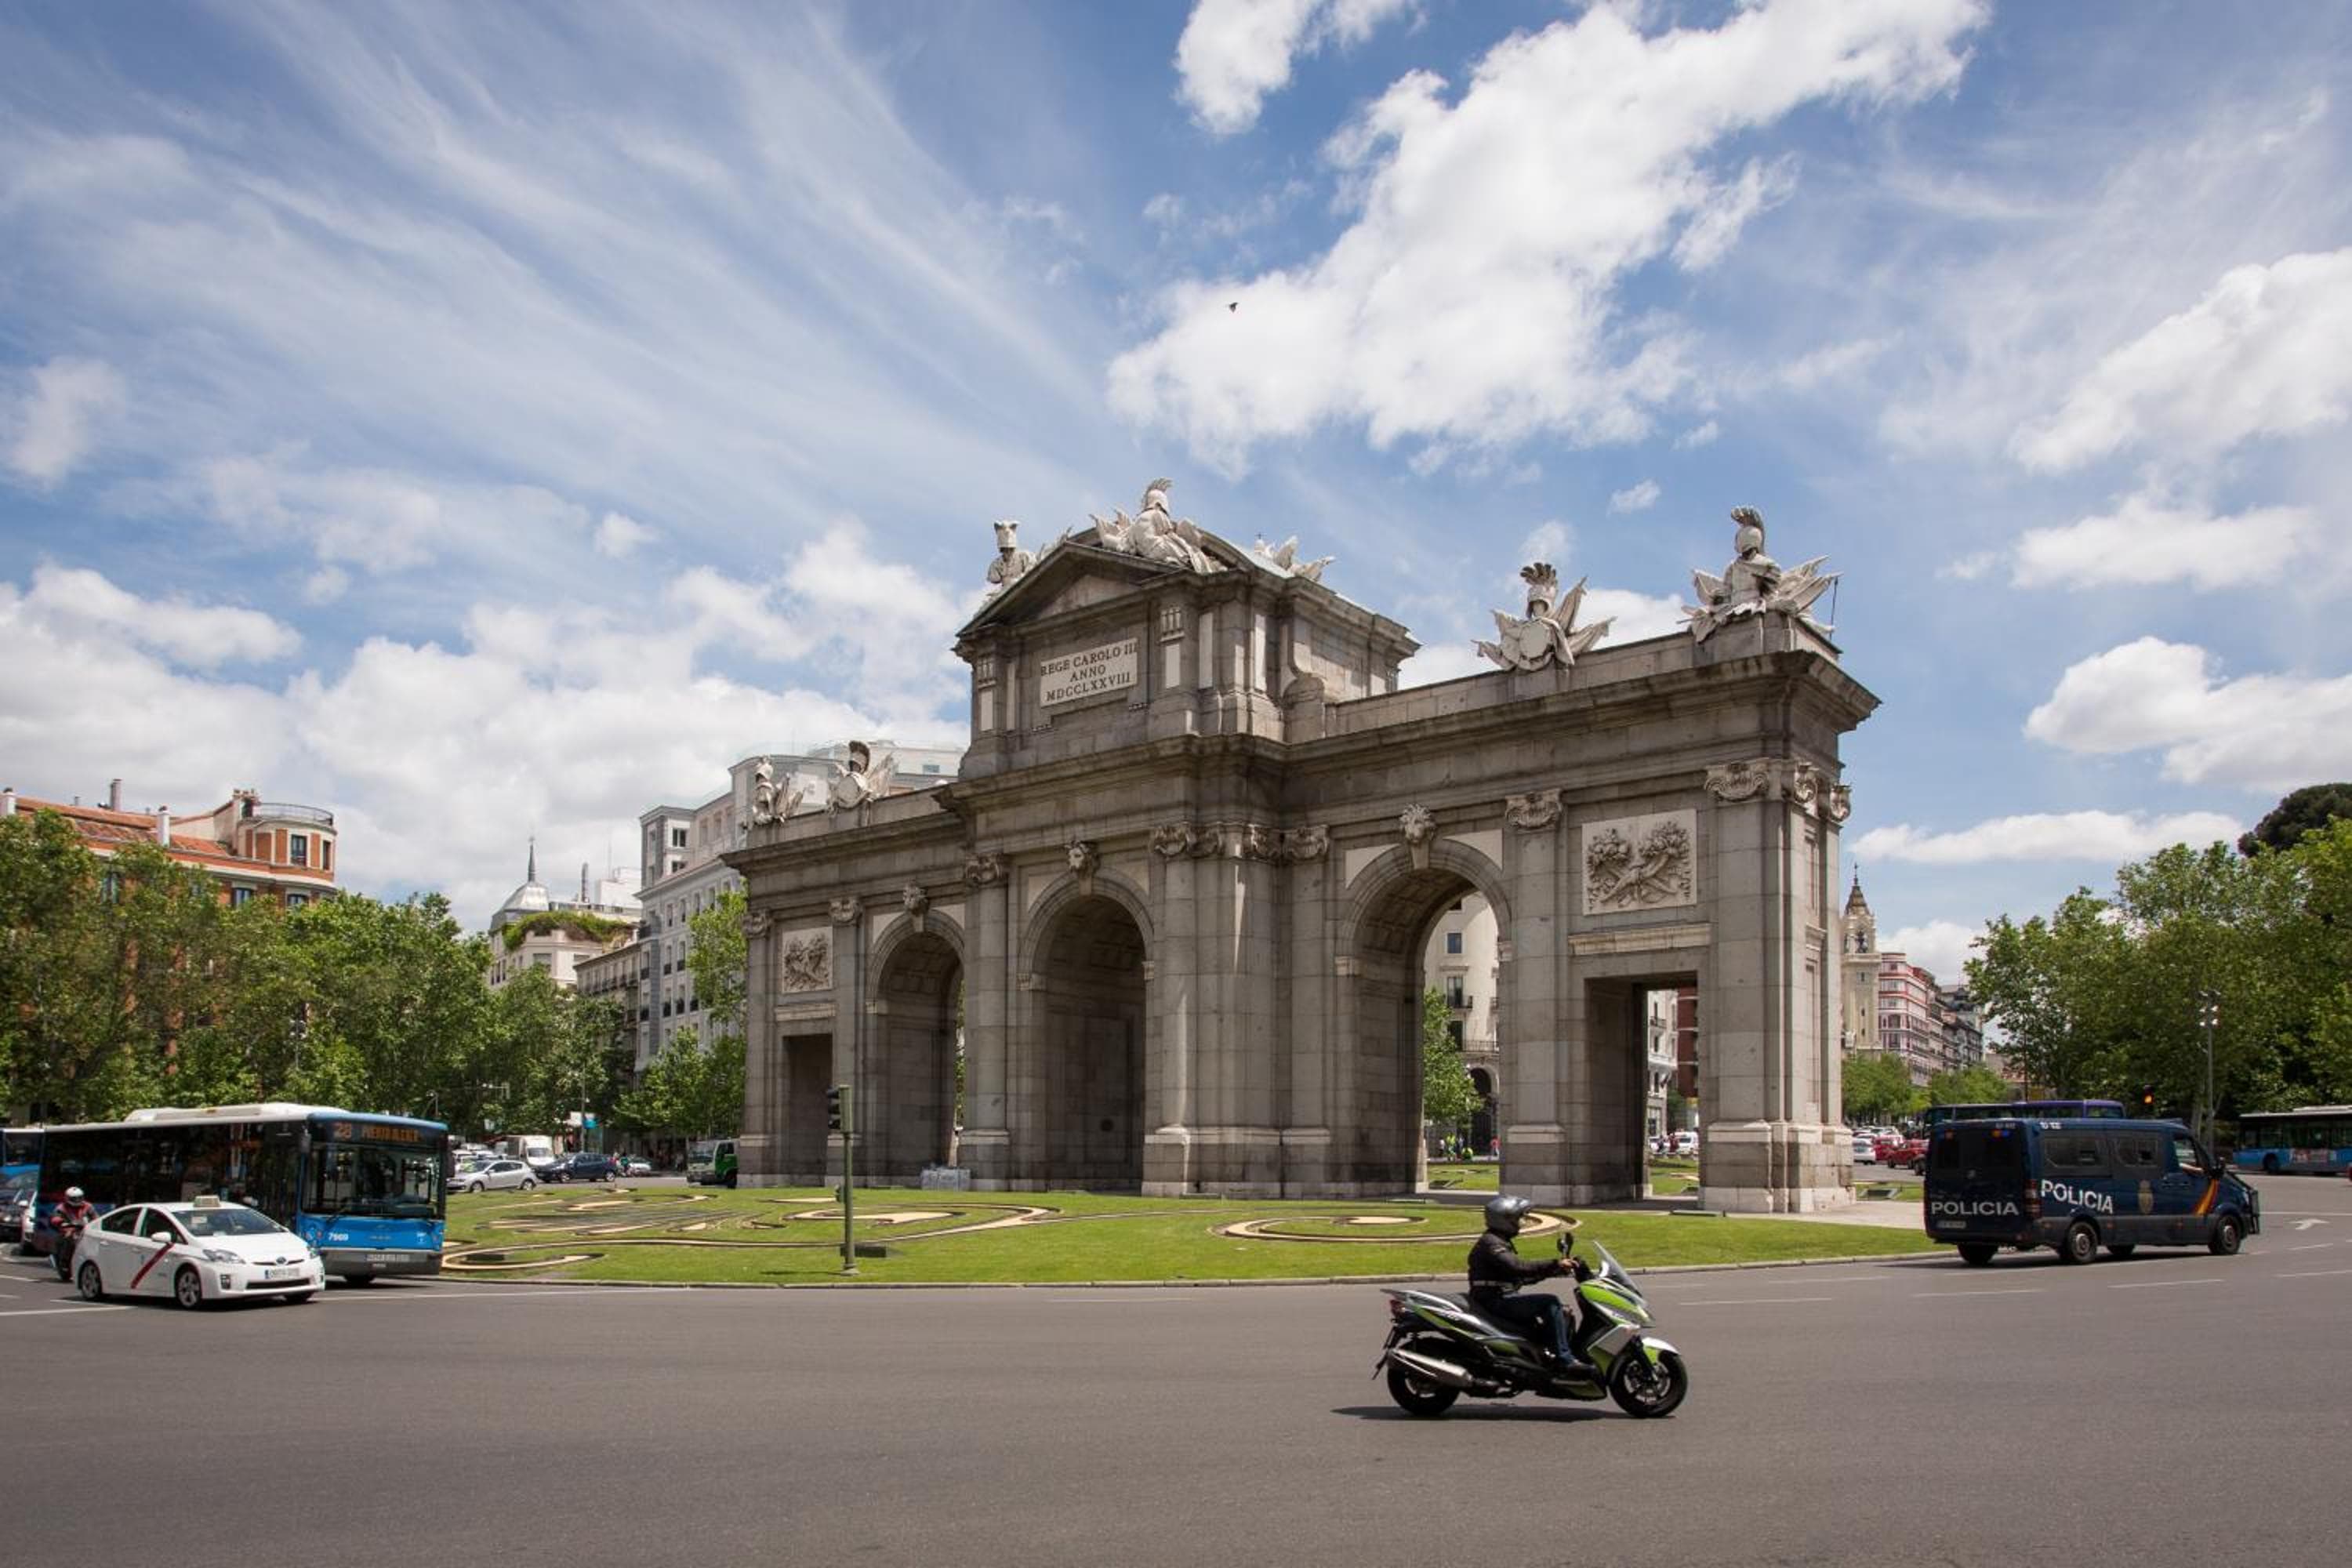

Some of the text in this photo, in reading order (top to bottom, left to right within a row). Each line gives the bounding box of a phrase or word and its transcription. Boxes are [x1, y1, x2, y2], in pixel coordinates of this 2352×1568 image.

[1041, 659, 1070, 676] REGE
[1073, 647, 1121, 667] CAROLO
[1070, 664, 1106, 682] ANNO
[1047, 672, 1131, 702] MDCCLXXVIII
[1931, 1201, 2020, 1216] POLICIA
[2041, 1179, 2114, 1214] POLICIA
